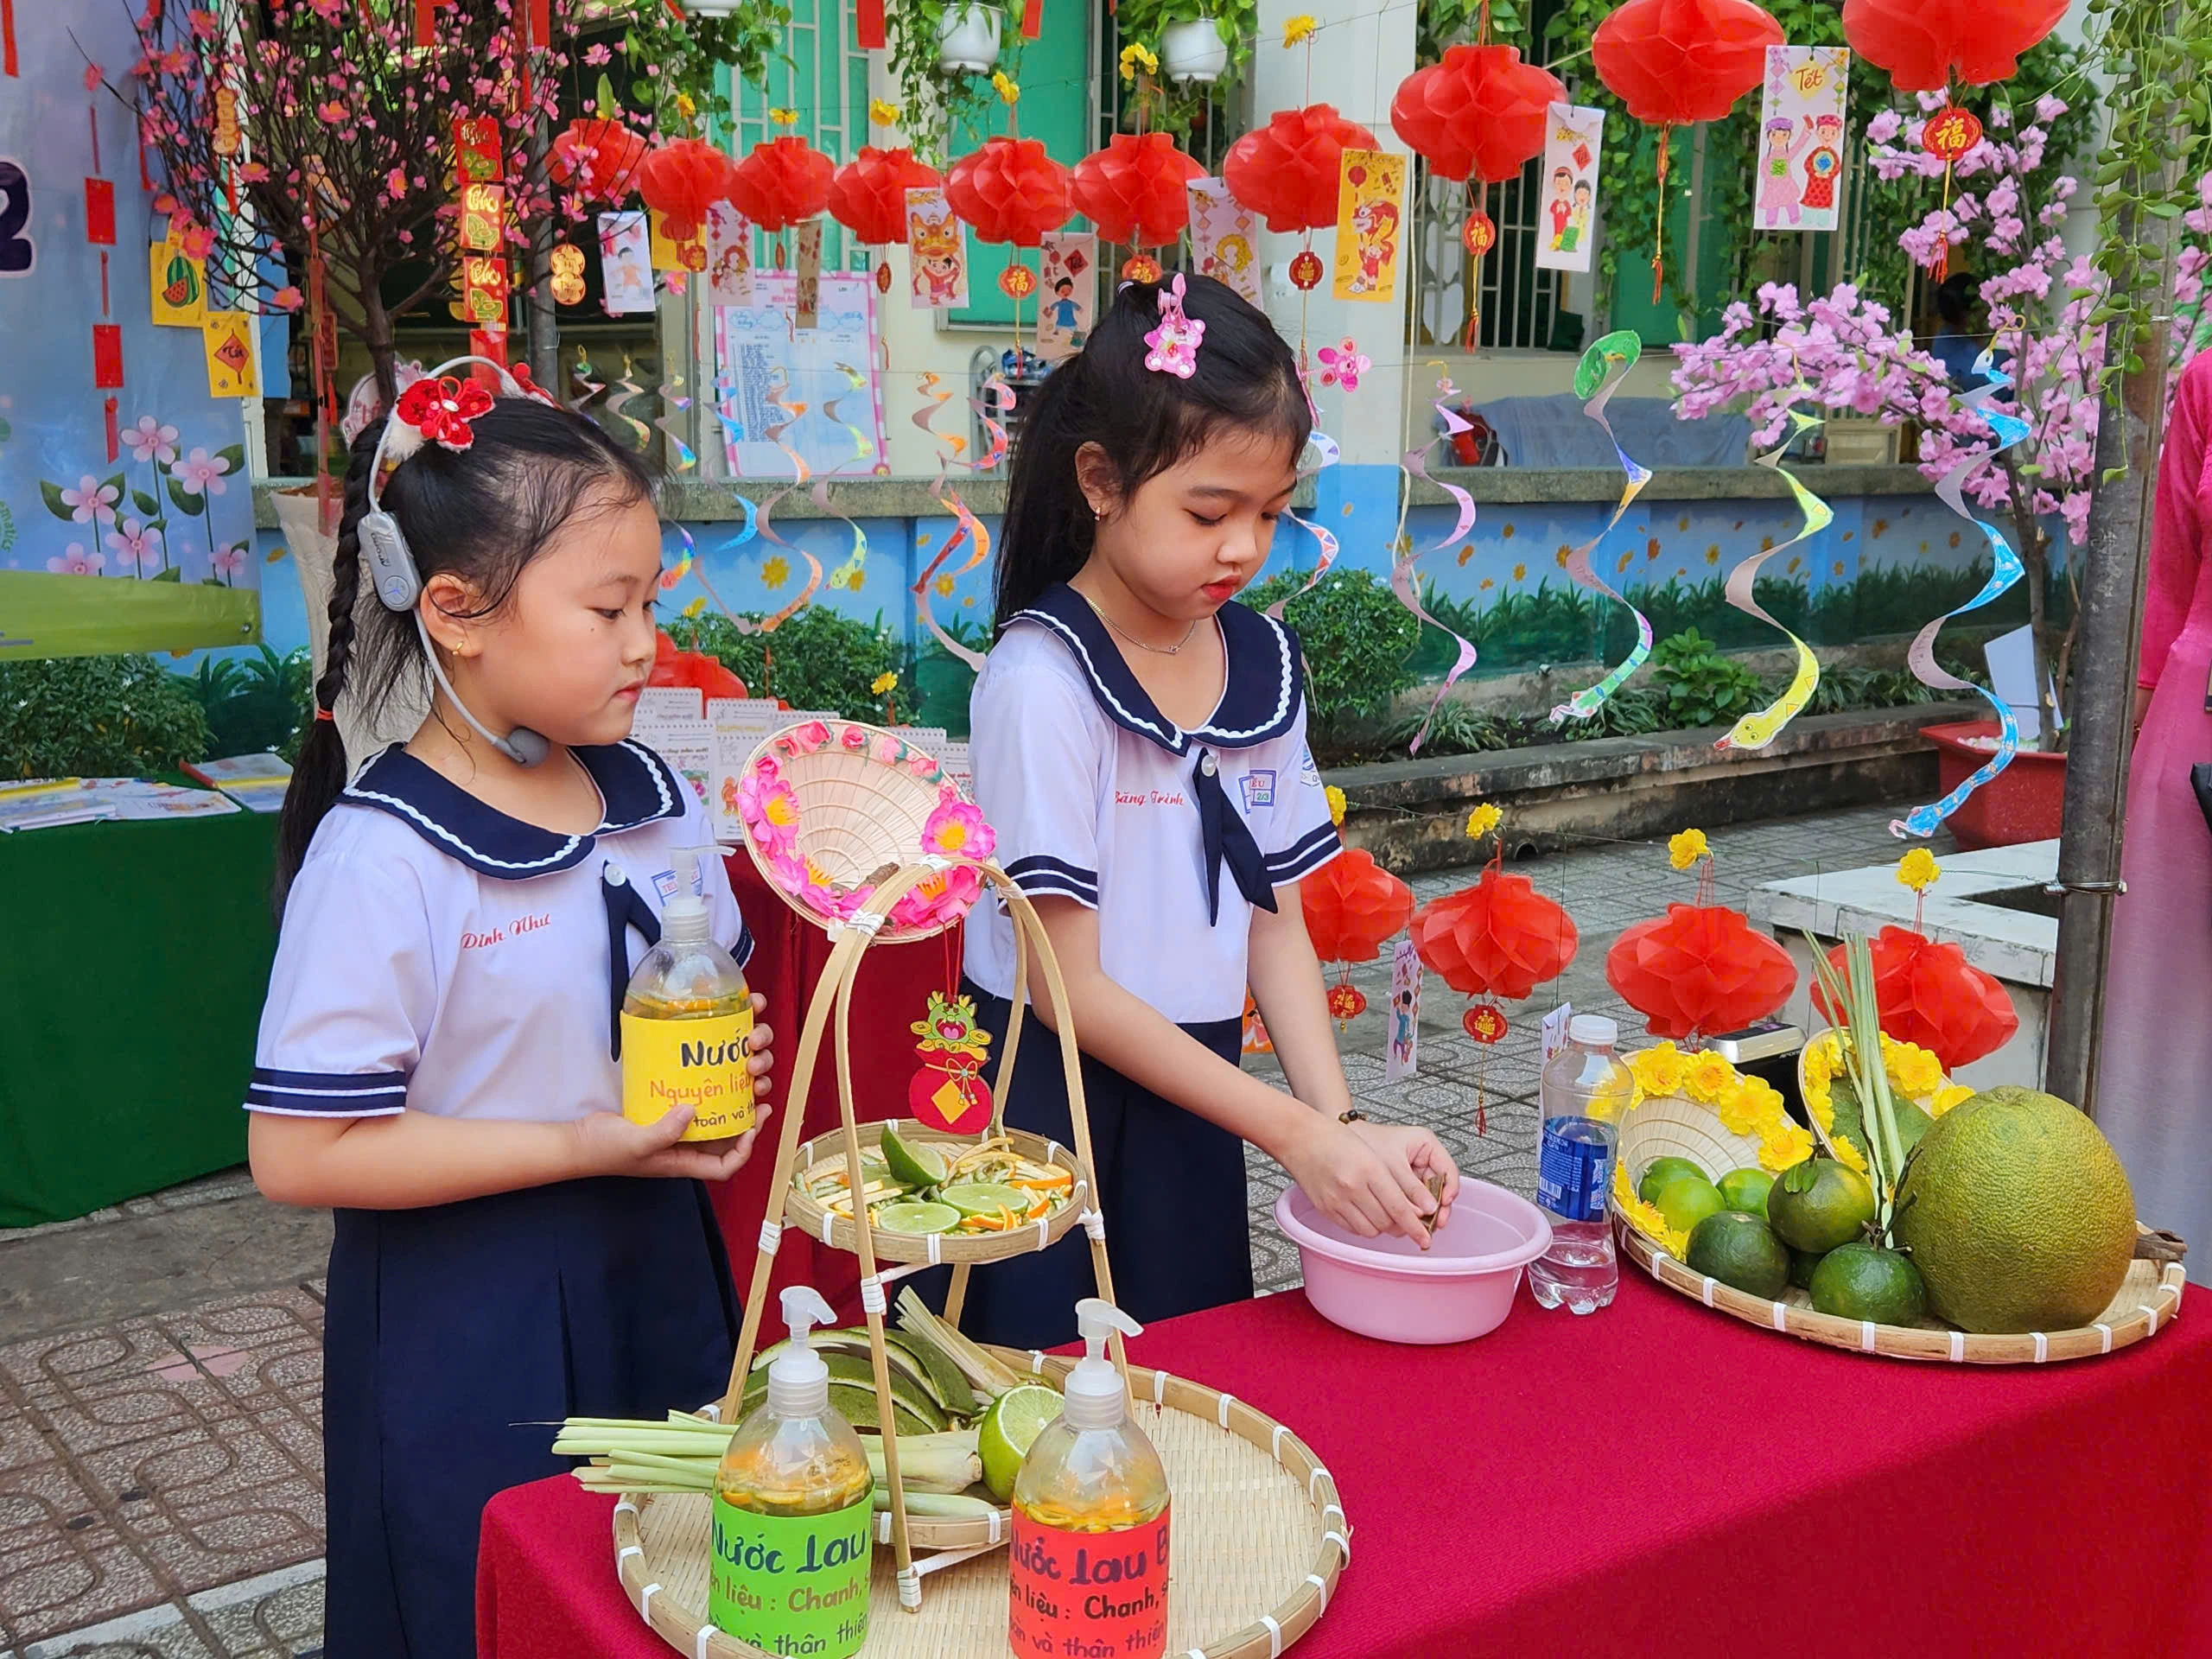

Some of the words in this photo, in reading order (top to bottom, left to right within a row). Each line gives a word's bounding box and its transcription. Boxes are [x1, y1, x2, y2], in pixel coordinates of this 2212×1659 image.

[1796, 67, 1822, 91] Tết
[1935, 117, 1967, 149] 福
[1470, 222, 1488, 247] 福
[1008, 271, 1029, 292] 福
[1256, 791, 1269, 801] 2/3
[681, 1028, 750, 1067] Nước
[650, 1078, 723, 1107] Nguyên
[693, 1111, 726, 1127] toàn
[732, 1106, 745, 1121] và
[712, 1514, 785, 1573] Nước
[726, 1576, 762, 1615] liệu
[788, 1576, 861, 1612] Chanh,
[1084, 1586, 1160, 1620] Chanh,
[774, 1633, 826, 1656] thân
[1032, 1631, 1053, 1654] và
[1063, 1637, 1115, 1659] thân
